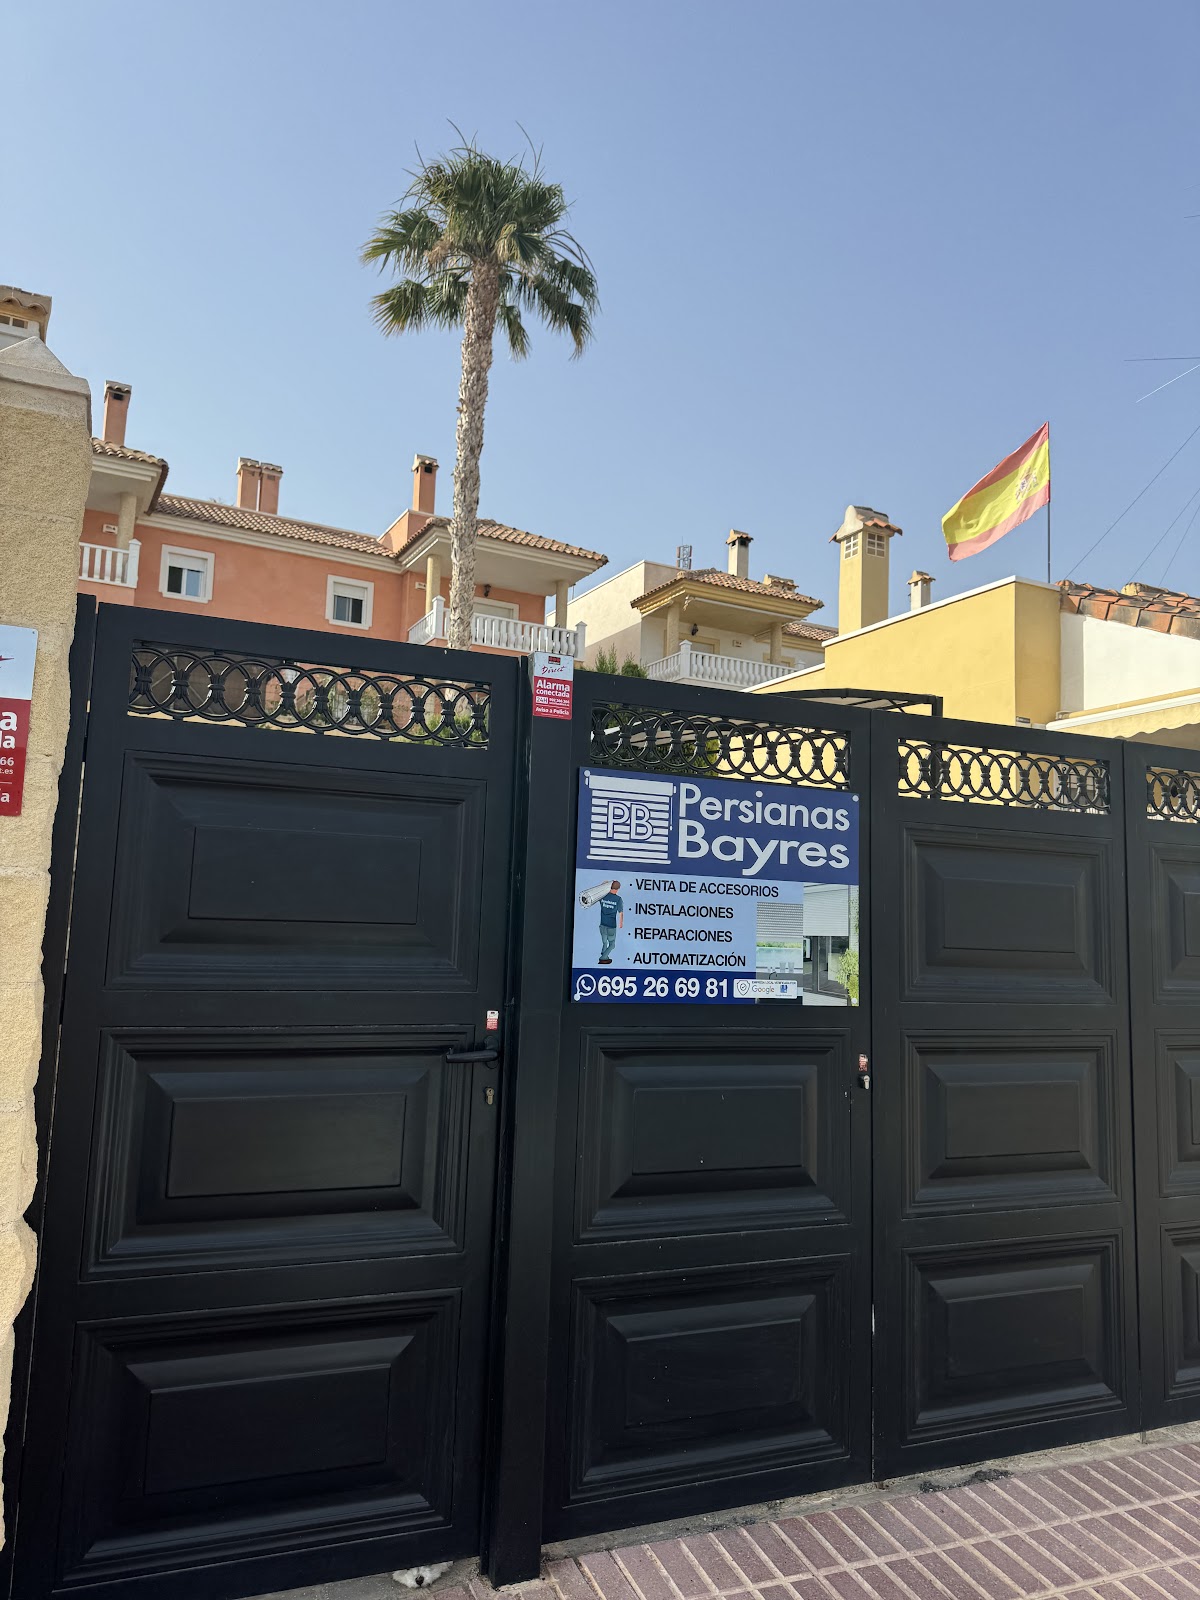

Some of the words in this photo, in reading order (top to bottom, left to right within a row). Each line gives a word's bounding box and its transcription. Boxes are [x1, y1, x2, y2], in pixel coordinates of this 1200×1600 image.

[536, 679, 570, 692] Alarma
[536, 688, 570, 698] conectada
[679, 782, 850, 831] Persianas
[607, 801, 653, 840] PB
[678, 819, 850, 876] Bayres
[635, 878, 676, 892] VENTA
[679, 881, 697, 893] DE
[699, 882, 779, 898] ACCESORIOS
[635, 902, 734, 919] INSTALACIONES
[634, 927, 733, 943] REPARACIONES
[633, 952, 746, 967] AUTOMATIZACIÓN
[597, 975, 637, 997] 695
[643, 976, 669, 998] 26
[674, 976, 700, 998] 69
[705, 977, 728, 998] 81
